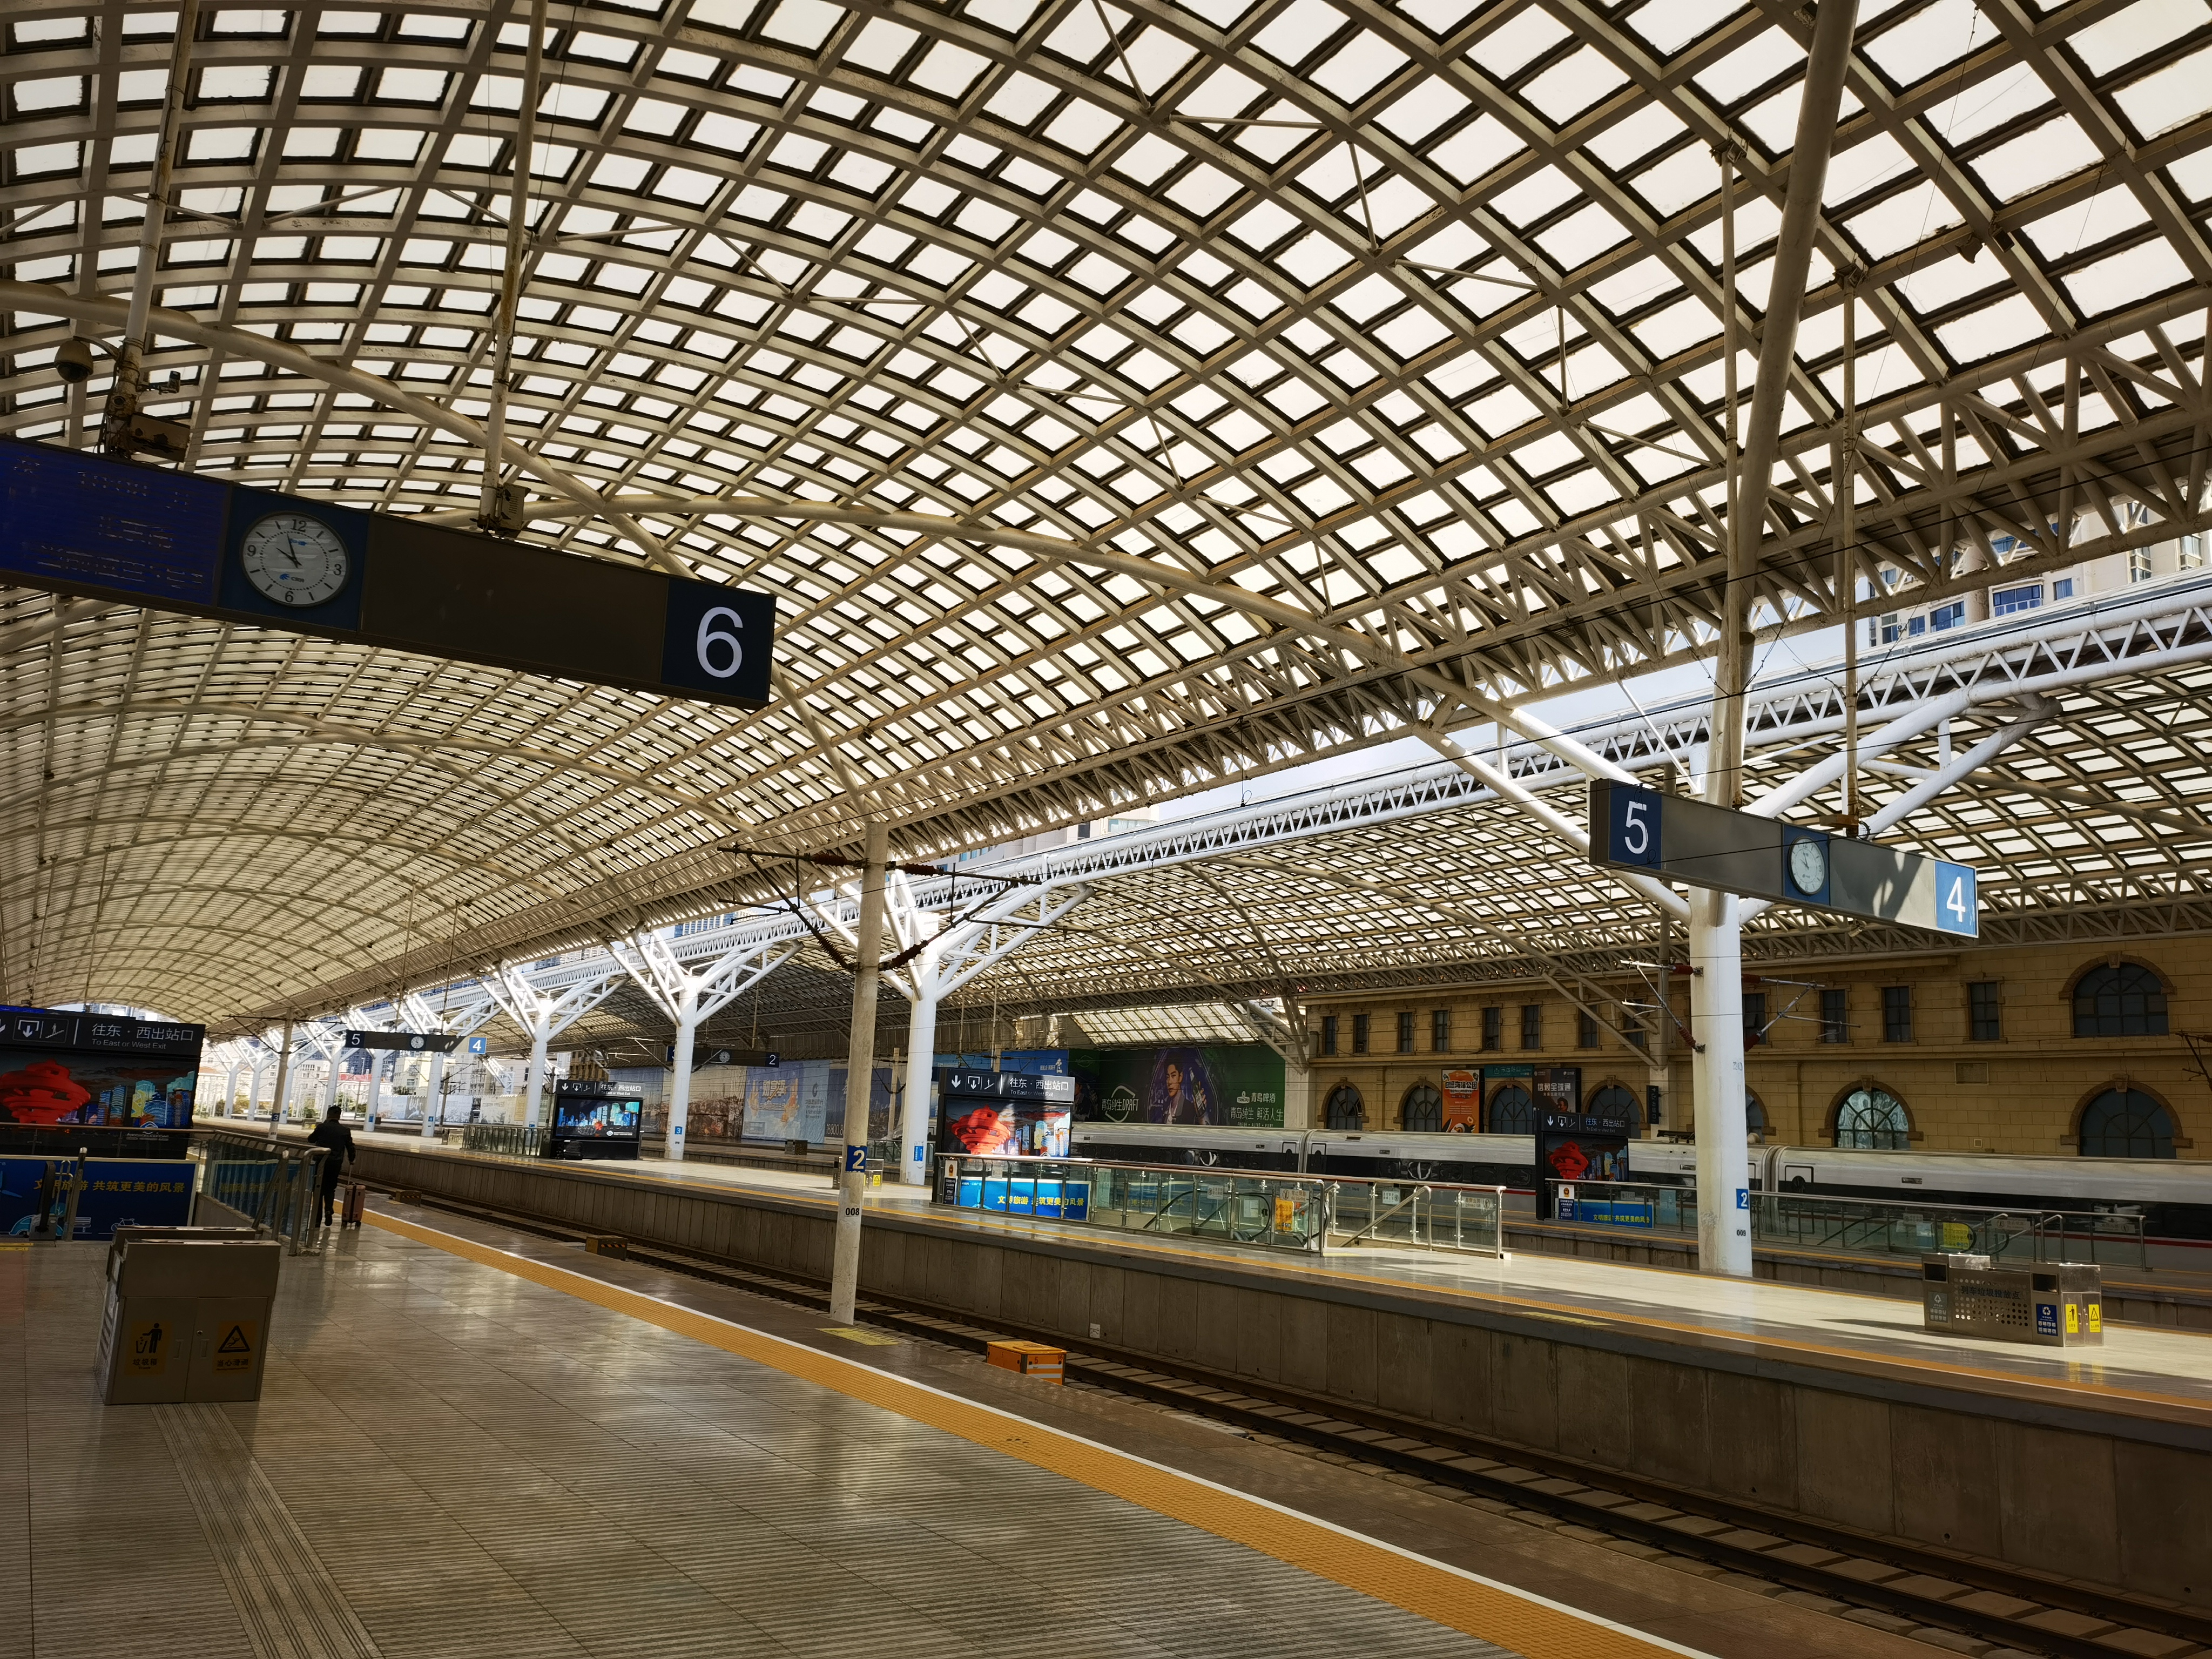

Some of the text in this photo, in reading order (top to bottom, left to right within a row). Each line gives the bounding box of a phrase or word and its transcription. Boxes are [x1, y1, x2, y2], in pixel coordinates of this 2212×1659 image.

[290, 519, 307, 532] 12
[247, 545, 257, 557] 9
[333, 564, 342, 576] 3
[285, 591, 294, 603] 6
[697, 606, 743, 678] 6
[1624, 800, 1648, 854] 5
[1946, 876, 1966, 922] 4
[352, 1034, 360, 1045] 5
[473, 1040, 481, 1051] 4
[769, 1055, 775, 1065] 2
[1230, 1107, 1284, 1121] 青岛纯生 鲜活人生
[852, 1150, 865, 1169] 2
[93, 1181, 185, 1192] 共筑更美的风景
[1741, 1192, 1748, 1207] 2
[845, 1208, 860, 1216] 008
